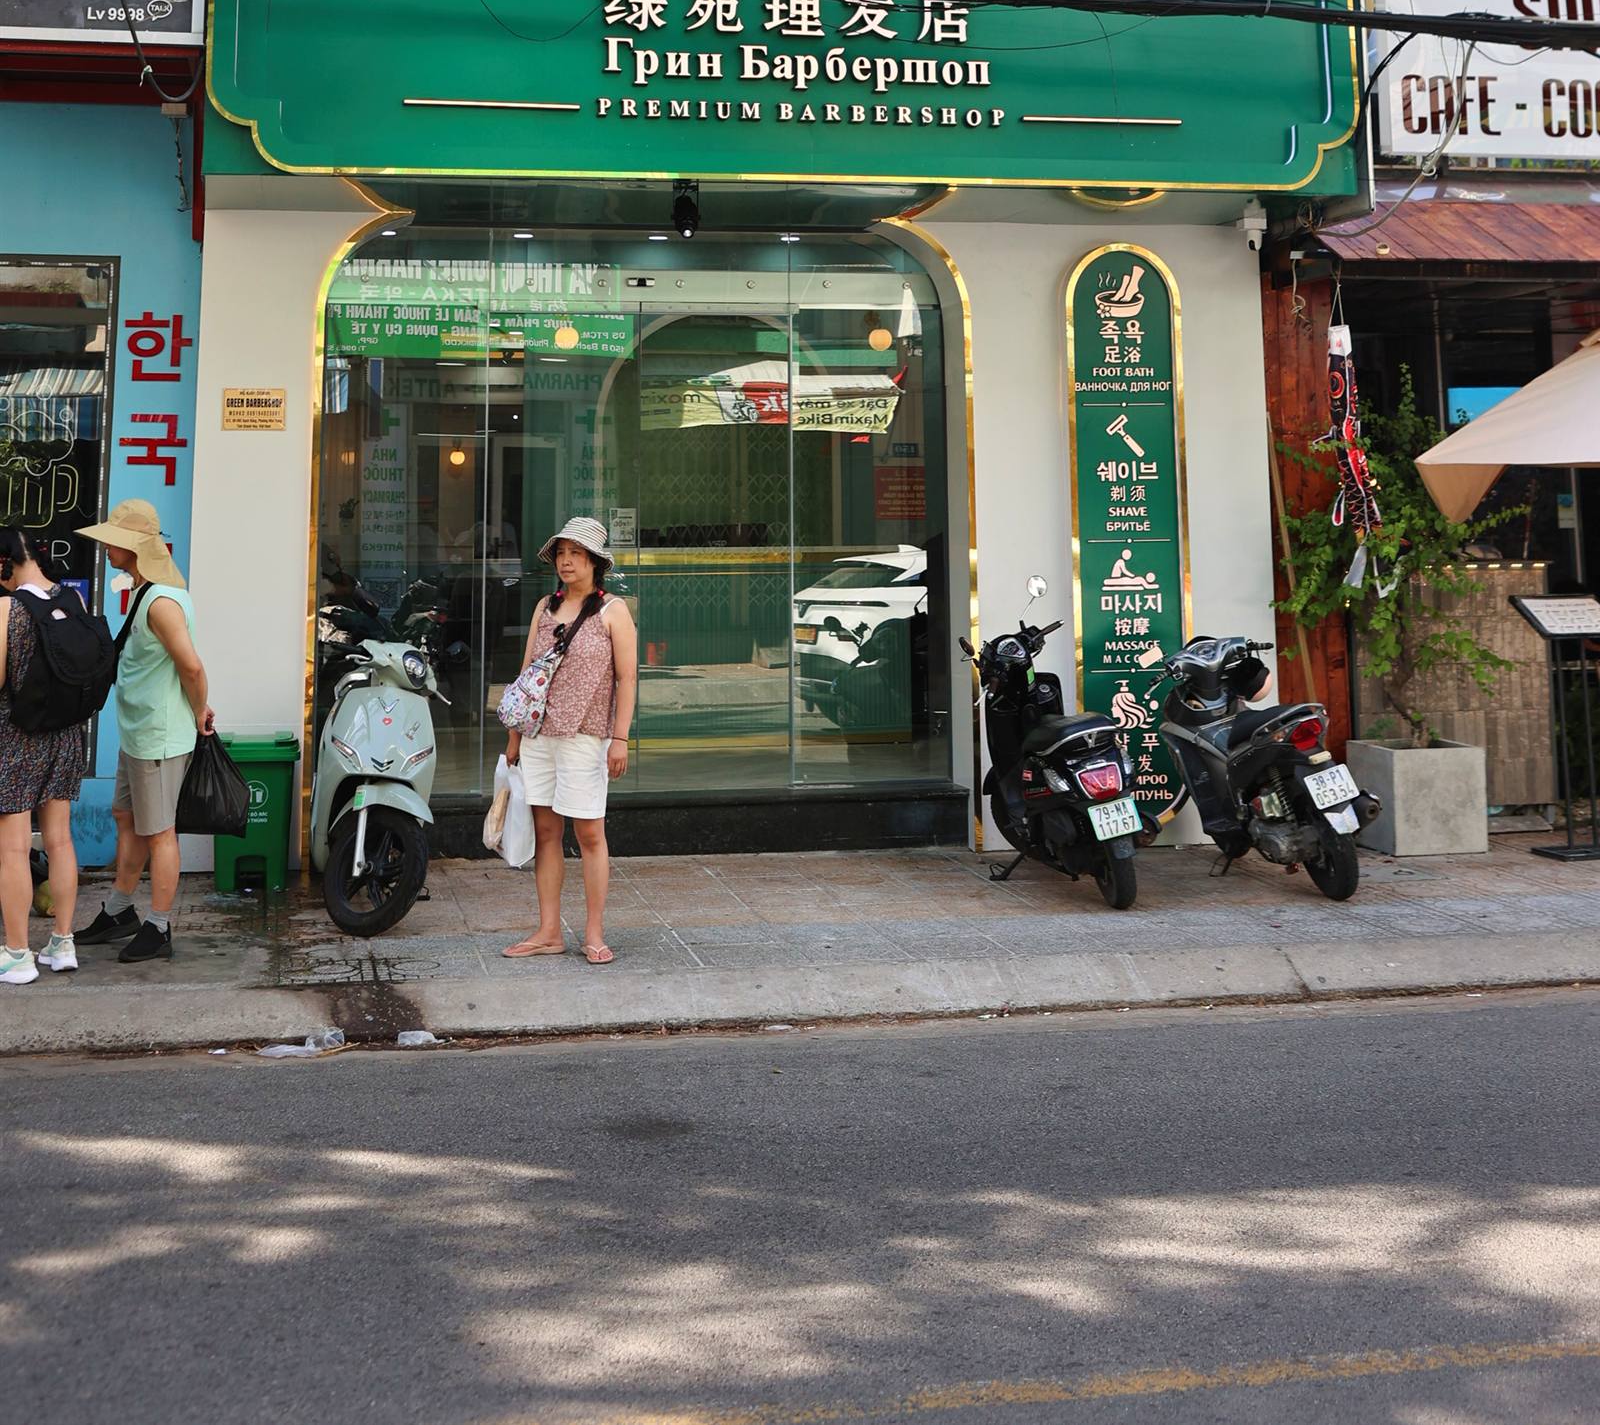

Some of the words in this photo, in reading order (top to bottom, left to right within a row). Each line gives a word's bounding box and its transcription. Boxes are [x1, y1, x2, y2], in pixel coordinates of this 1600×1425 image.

[87, 6, 106, 21] Lv
[107, 7, 145, 22] 9998
[150, 4, 171, 12] TALK
[603, 37, 723, 84] Грин
[739, 45, 992, 92] Барбершоп
[598, 98, 762, 120] PREMIUM
[779, 103, 1005, 127] BARBERSHOP
[1401, 74, 1502, 136] CAFE
[1542, 78, 1600, 138] CO
[1099, 319, 1145, 344] 족욕
[1104, 345, 1142, 364] 足浴
[1092, 367, 1122, 377] FOOT
[1124, 367, 1155, 377] BATH
[1075, 381, 1128, 393] ВАННОЧКА
[1129, 381, 1151, 394] ДЛЯ
[1152, 380, 1172, 392] НОГ
[226, 398, 245, 408] GREEN
[245, 398, 283, 408] BARBERSHOP
[1096, 460, 1159, 482] 쉐이브
[1110, 485, 1147, 502] 剃须
[1108, 506, 1149, 517] SHAVE
[1106, 520, 1152, 532] БРИТЬЁ
[1100, 593, 1163, 615] 마사지
[1114, 617, 1151, 636] 按摩
[1105, 640, 1161, 652] MASSAGE
